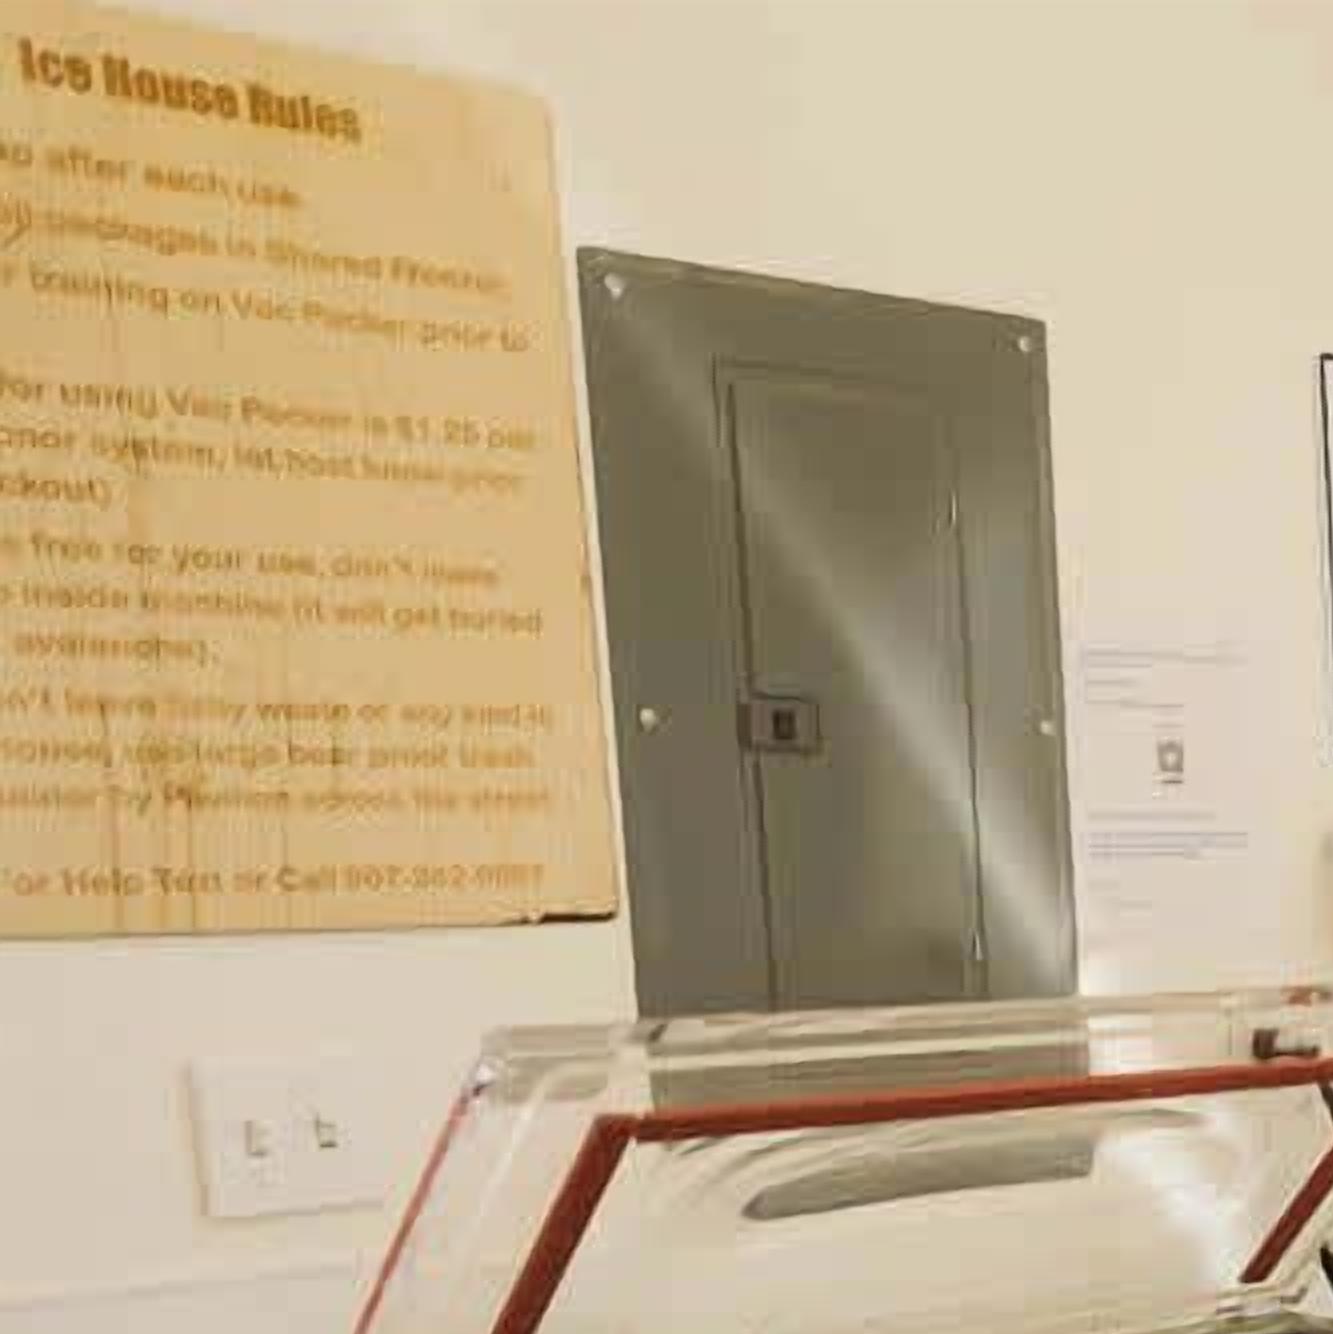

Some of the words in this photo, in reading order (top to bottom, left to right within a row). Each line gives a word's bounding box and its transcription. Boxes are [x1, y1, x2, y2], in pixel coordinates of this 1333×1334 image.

[18, 38, 94, 94] Ice
[102, 52, 240, 122] House
[247, 80, 362, 143] Rules
[178, 288, 222, 315] on
